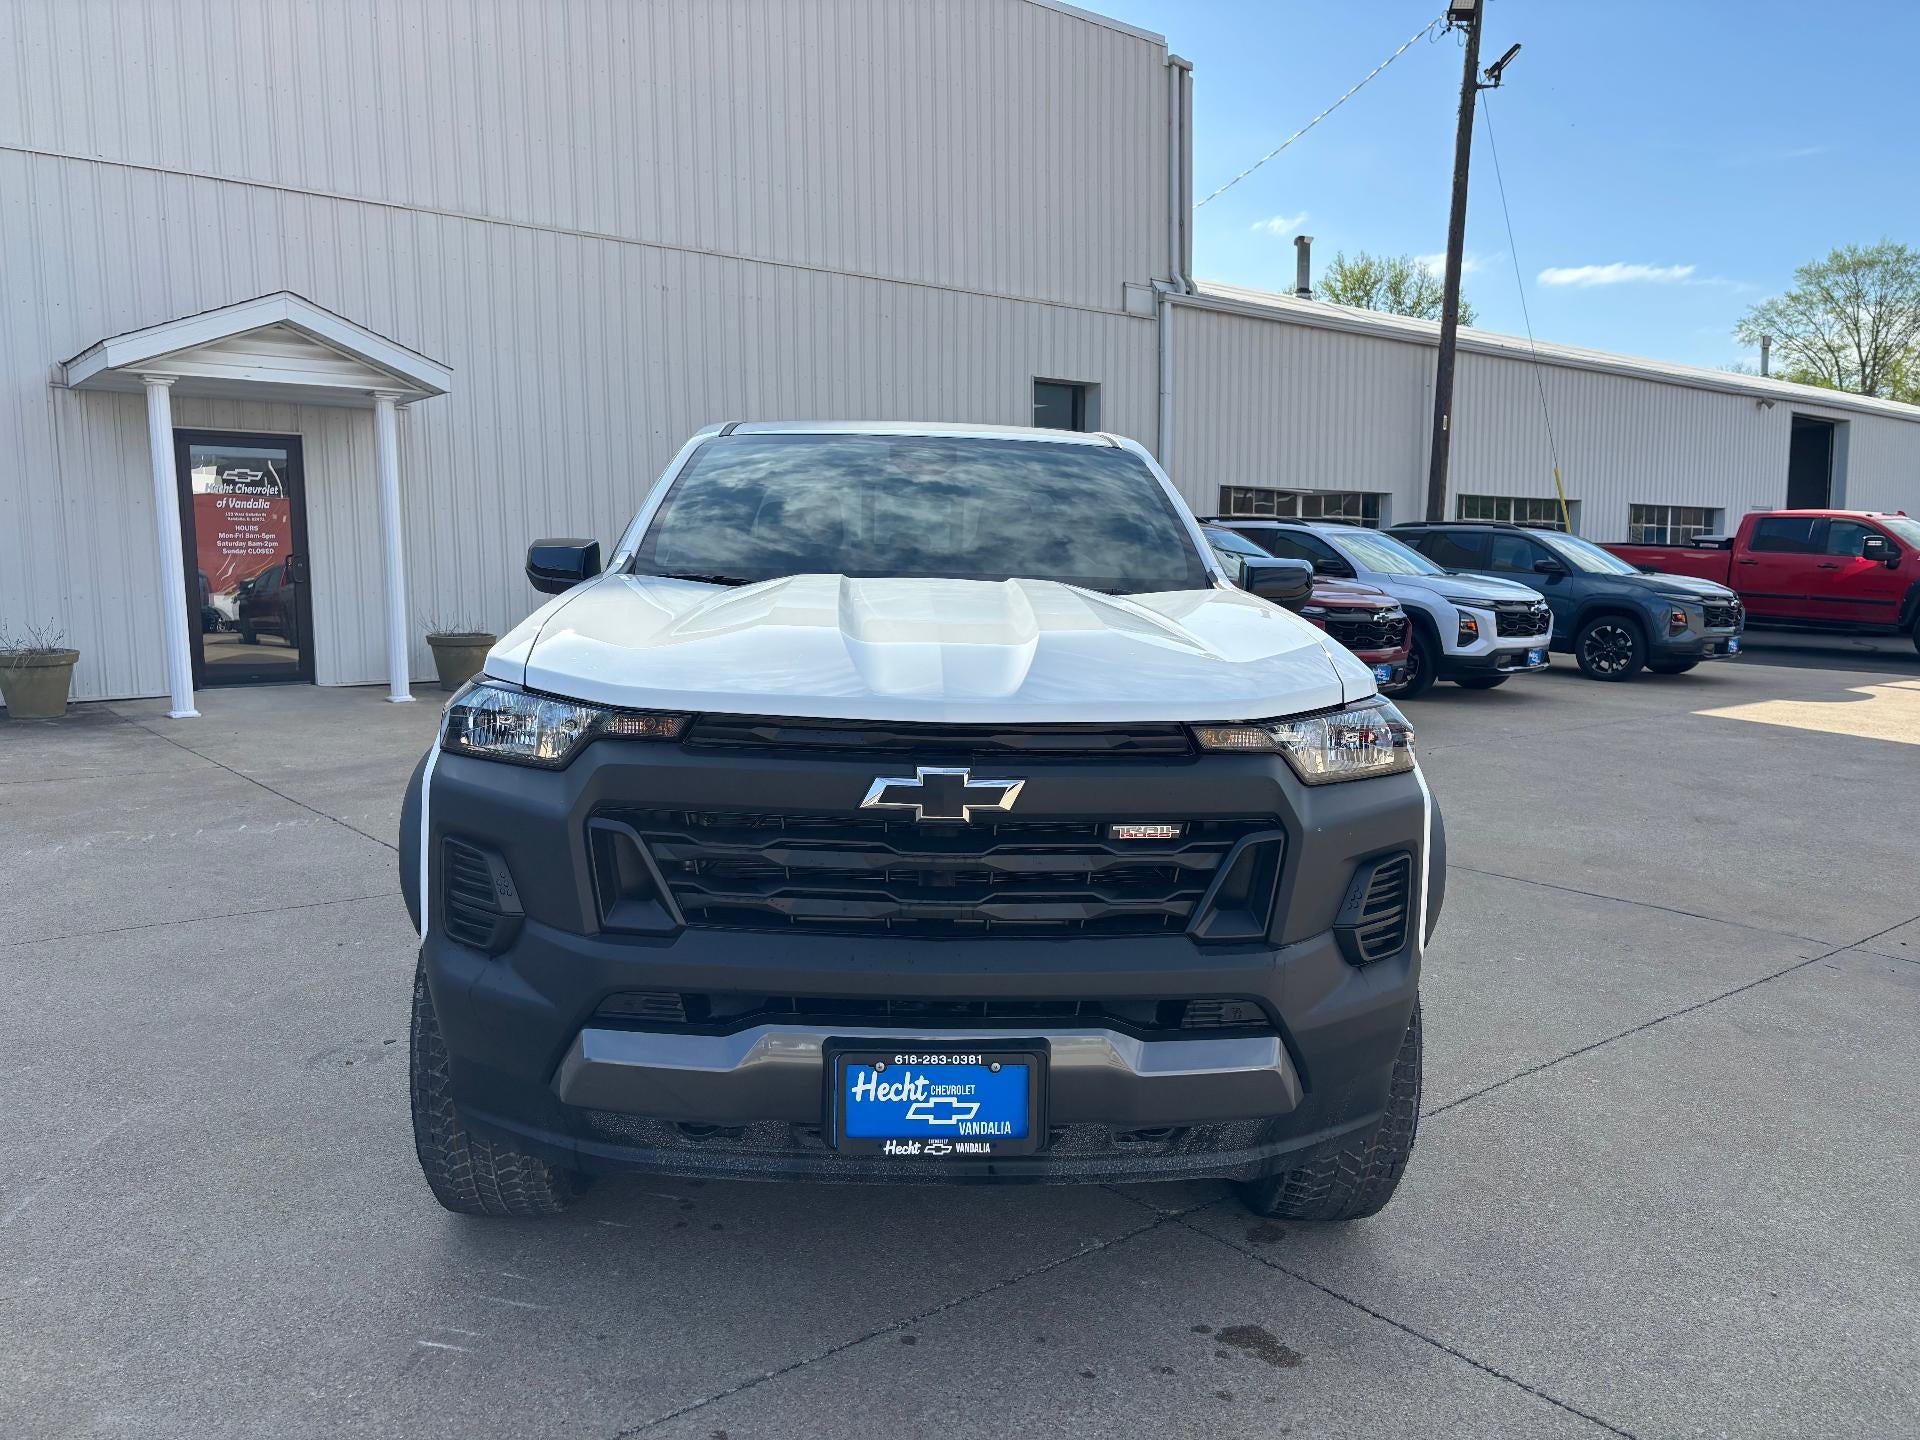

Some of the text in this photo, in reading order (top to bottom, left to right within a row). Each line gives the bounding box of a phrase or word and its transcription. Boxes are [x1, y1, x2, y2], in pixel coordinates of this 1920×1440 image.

[235, 483, 279, 496] Chevrolet
[216, 497, 271, 509] of Vandalia
[216, 540, 247, 548] Saturday
[1112, 825, 1180, 833] TRAIL
[894, 1054, 983, 1065] 618-283-0381
[851, 1070, 976, 1102] Hecht CHEVROLET
[958, 1121, 1012, 1136] VANDALIA
[883, 1140, 991, 1155] Hecht VANDALIA
